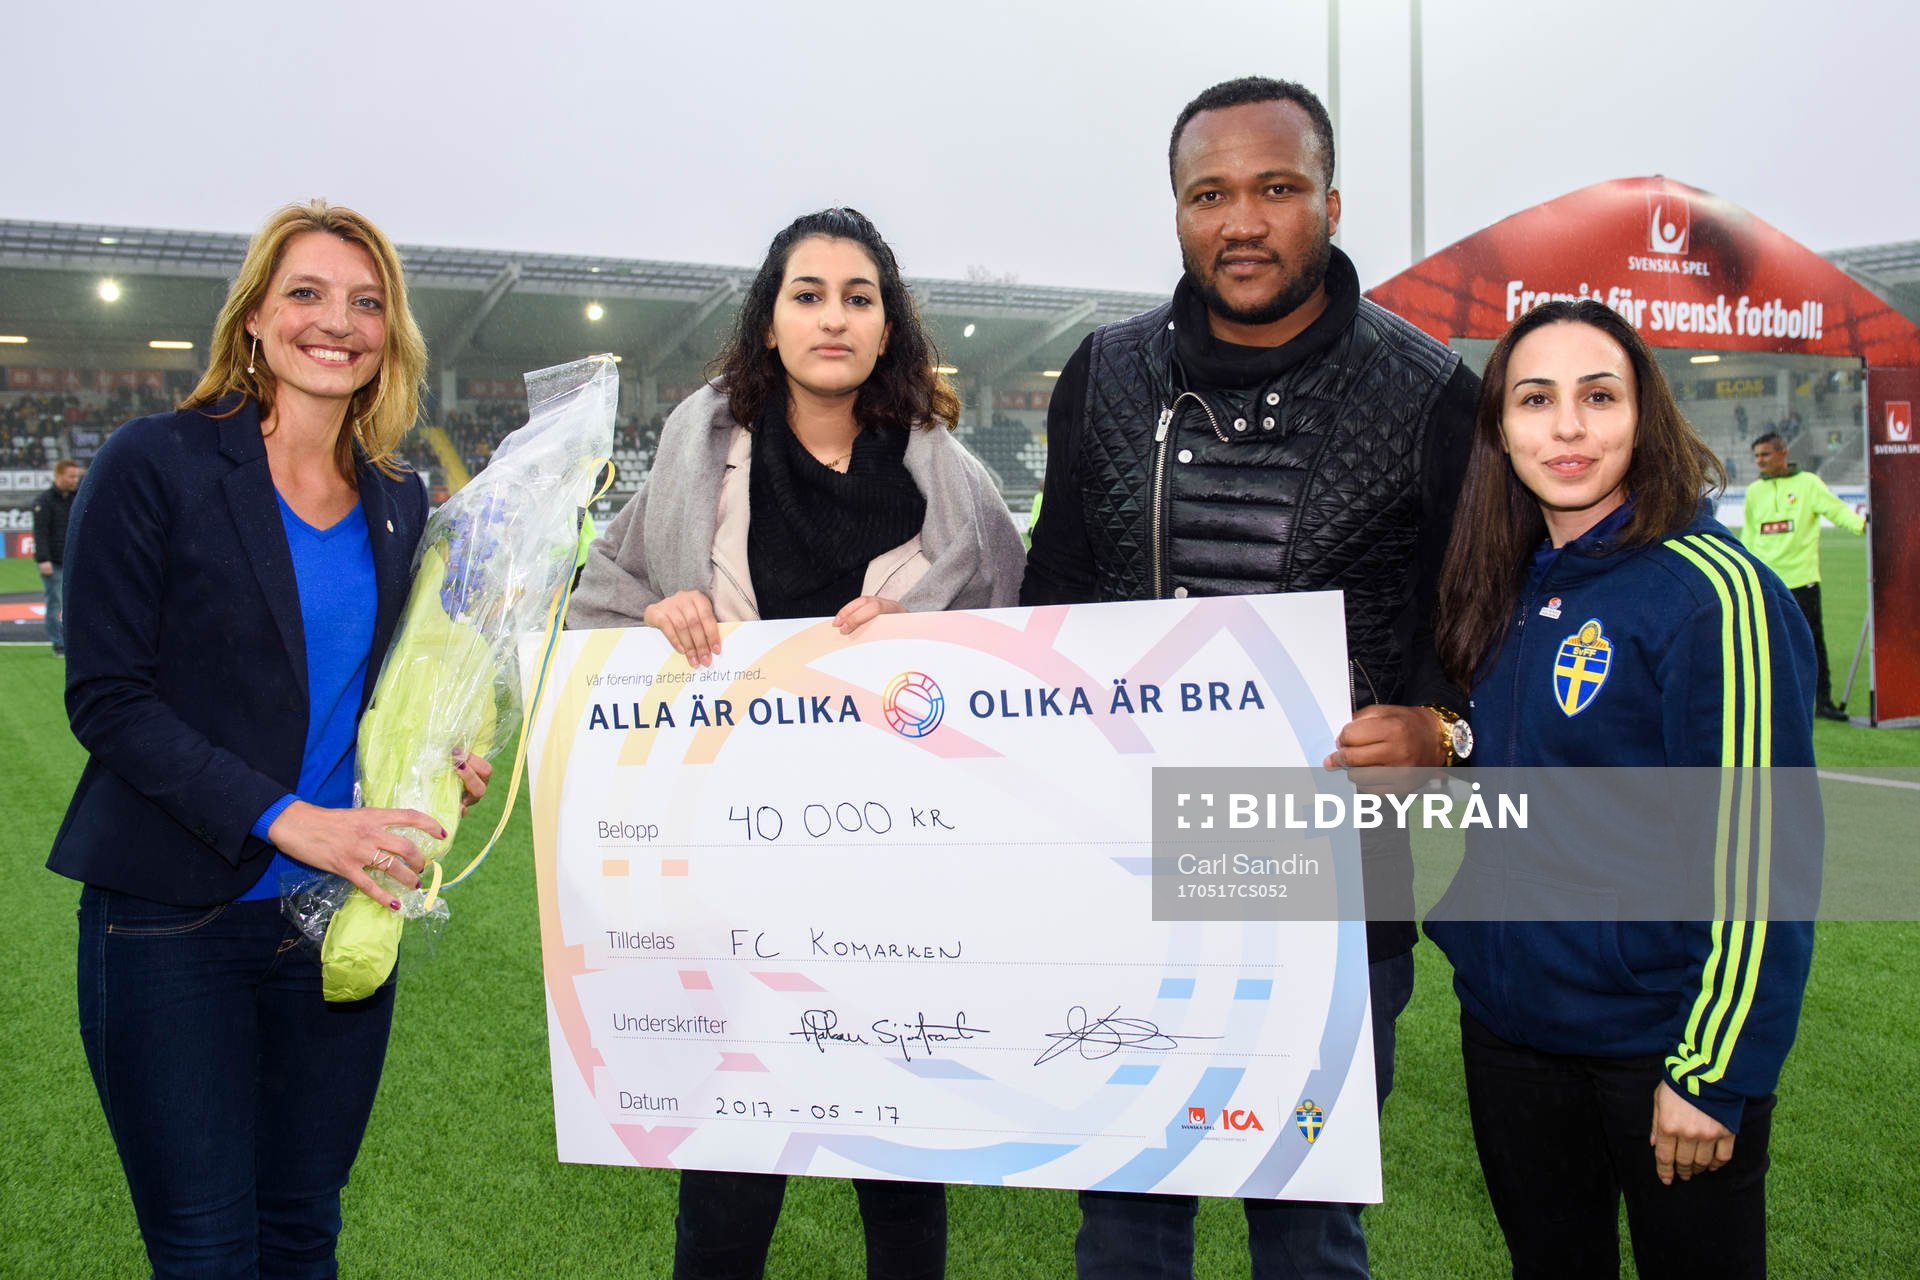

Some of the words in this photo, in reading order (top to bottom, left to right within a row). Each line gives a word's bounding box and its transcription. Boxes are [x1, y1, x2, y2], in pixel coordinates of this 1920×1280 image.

[1627, 255, 1680, 274] SVENSKA
[1681, 260, 1711, 277] SPEL
[1607, 285, 1647, 330] för
[1650, 294, 1733, 336] svensk
[1735, 295, 1824, 341] fotboll!
[1874, 443, 1907, 455] SVENSKA
[585, 673, 604, 687] Vår
[606, 672, 653, 687] förening
[655, 671, 697, 685] arbetar
[699, 669, 730, 682] aktivt
[969, 687, 1093, 719] OLIKA
[1109, 678, 1164, 715] ÄR
[1180, 680, 1266, 712] BRA
[589, 702, 676, 731] ALLA
[689, 694, 735, 728] ÄR
[748, 695, 862, 726] OLIKA
[597, 820, 659, 842] Belopp
[728, 805, 783, 842] 40
[803, 801, 892, 838] 000
[910, 807, 955, 830] KR
[605, 930, 676, 950] Tilldelas
[731, 929, 780, 959] FC
[613, 1012, 728, 1034] Underskrifter
[619, 1091, 679, 1111] Datum
[1222, 1108, 1265, 1132] ICA
